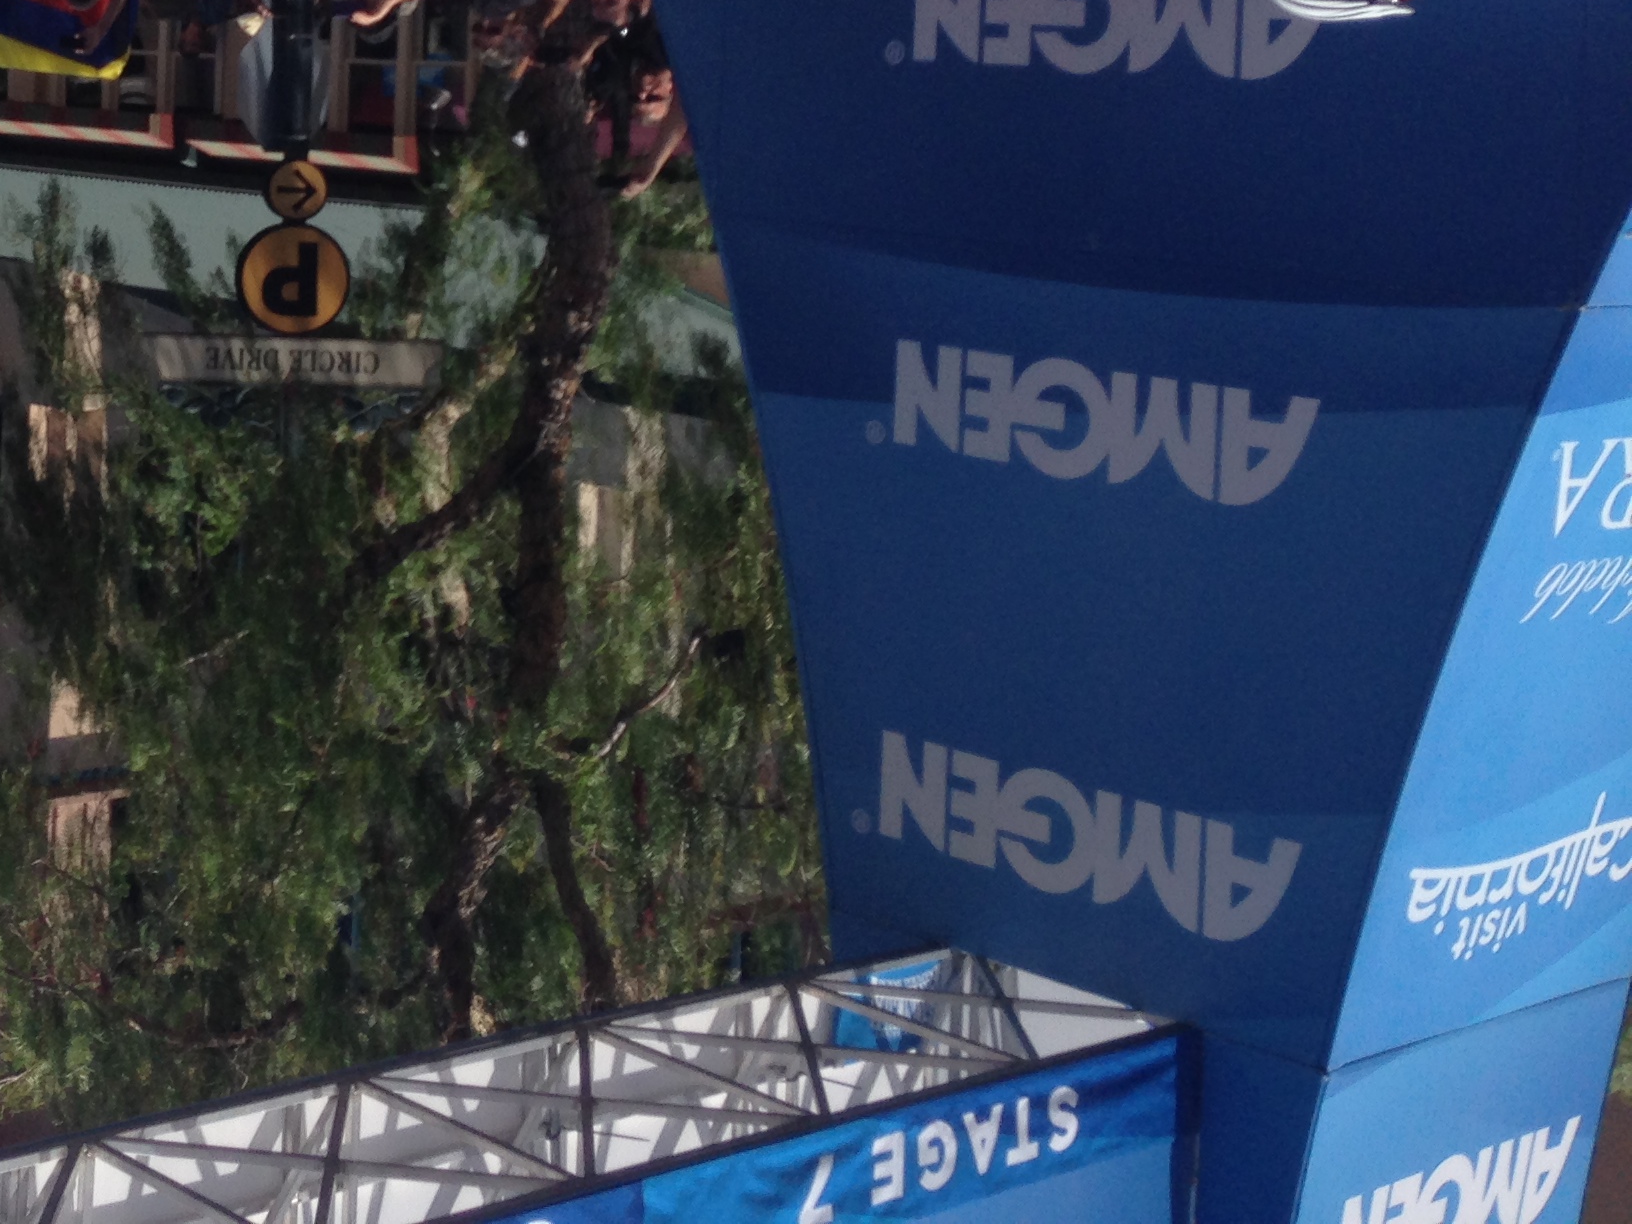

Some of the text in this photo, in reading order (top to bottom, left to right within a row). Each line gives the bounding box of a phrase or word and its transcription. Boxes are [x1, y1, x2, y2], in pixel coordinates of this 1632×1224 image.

[261, 242, 318, 317] P
[205, 346, 380, 375] CIRCLE DRIVE
[892, 339, 1321, 506] AMGEN
[879, 730, 1303, 942] AMGEN
[1451, 900, 1528, 960] visit
[797, 1085, 1079, 1224] STAGE 7
